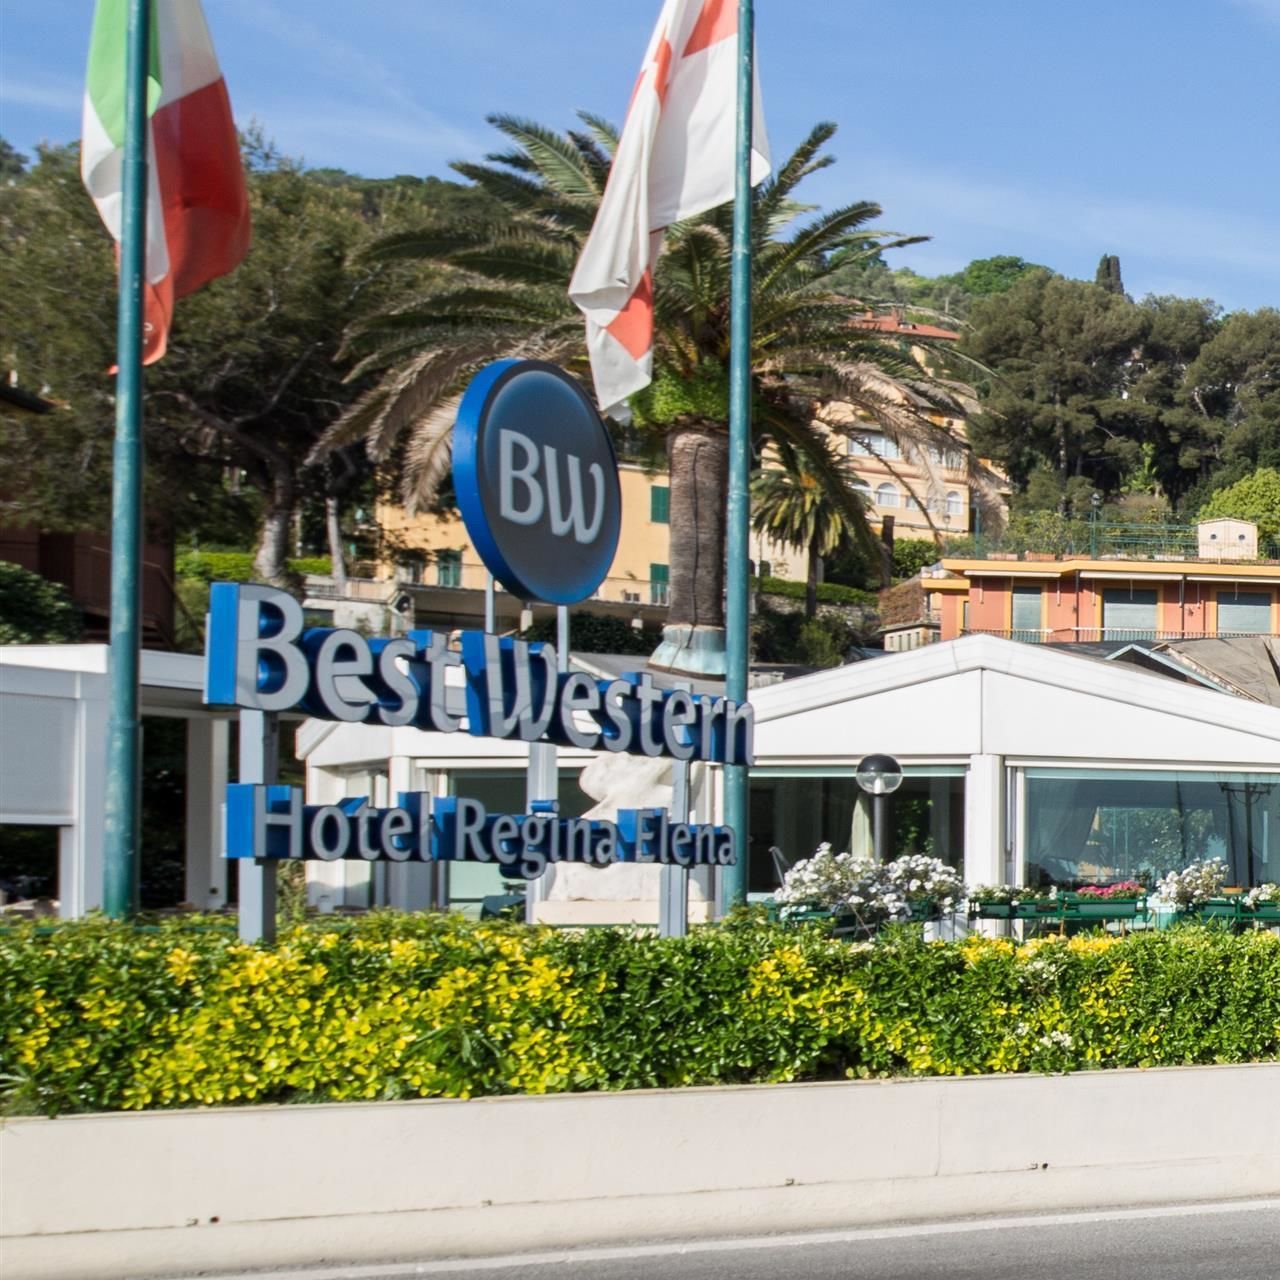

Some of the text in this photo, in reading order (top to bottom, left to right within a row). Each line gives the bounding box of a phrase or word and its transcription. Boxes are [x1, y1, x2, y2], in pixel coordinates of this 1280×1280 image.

[500, 428, 606, 545] BW
[235, 583, 755, 766] Best Western
[254, 784, 738, 881] Hotel Regina Elena
